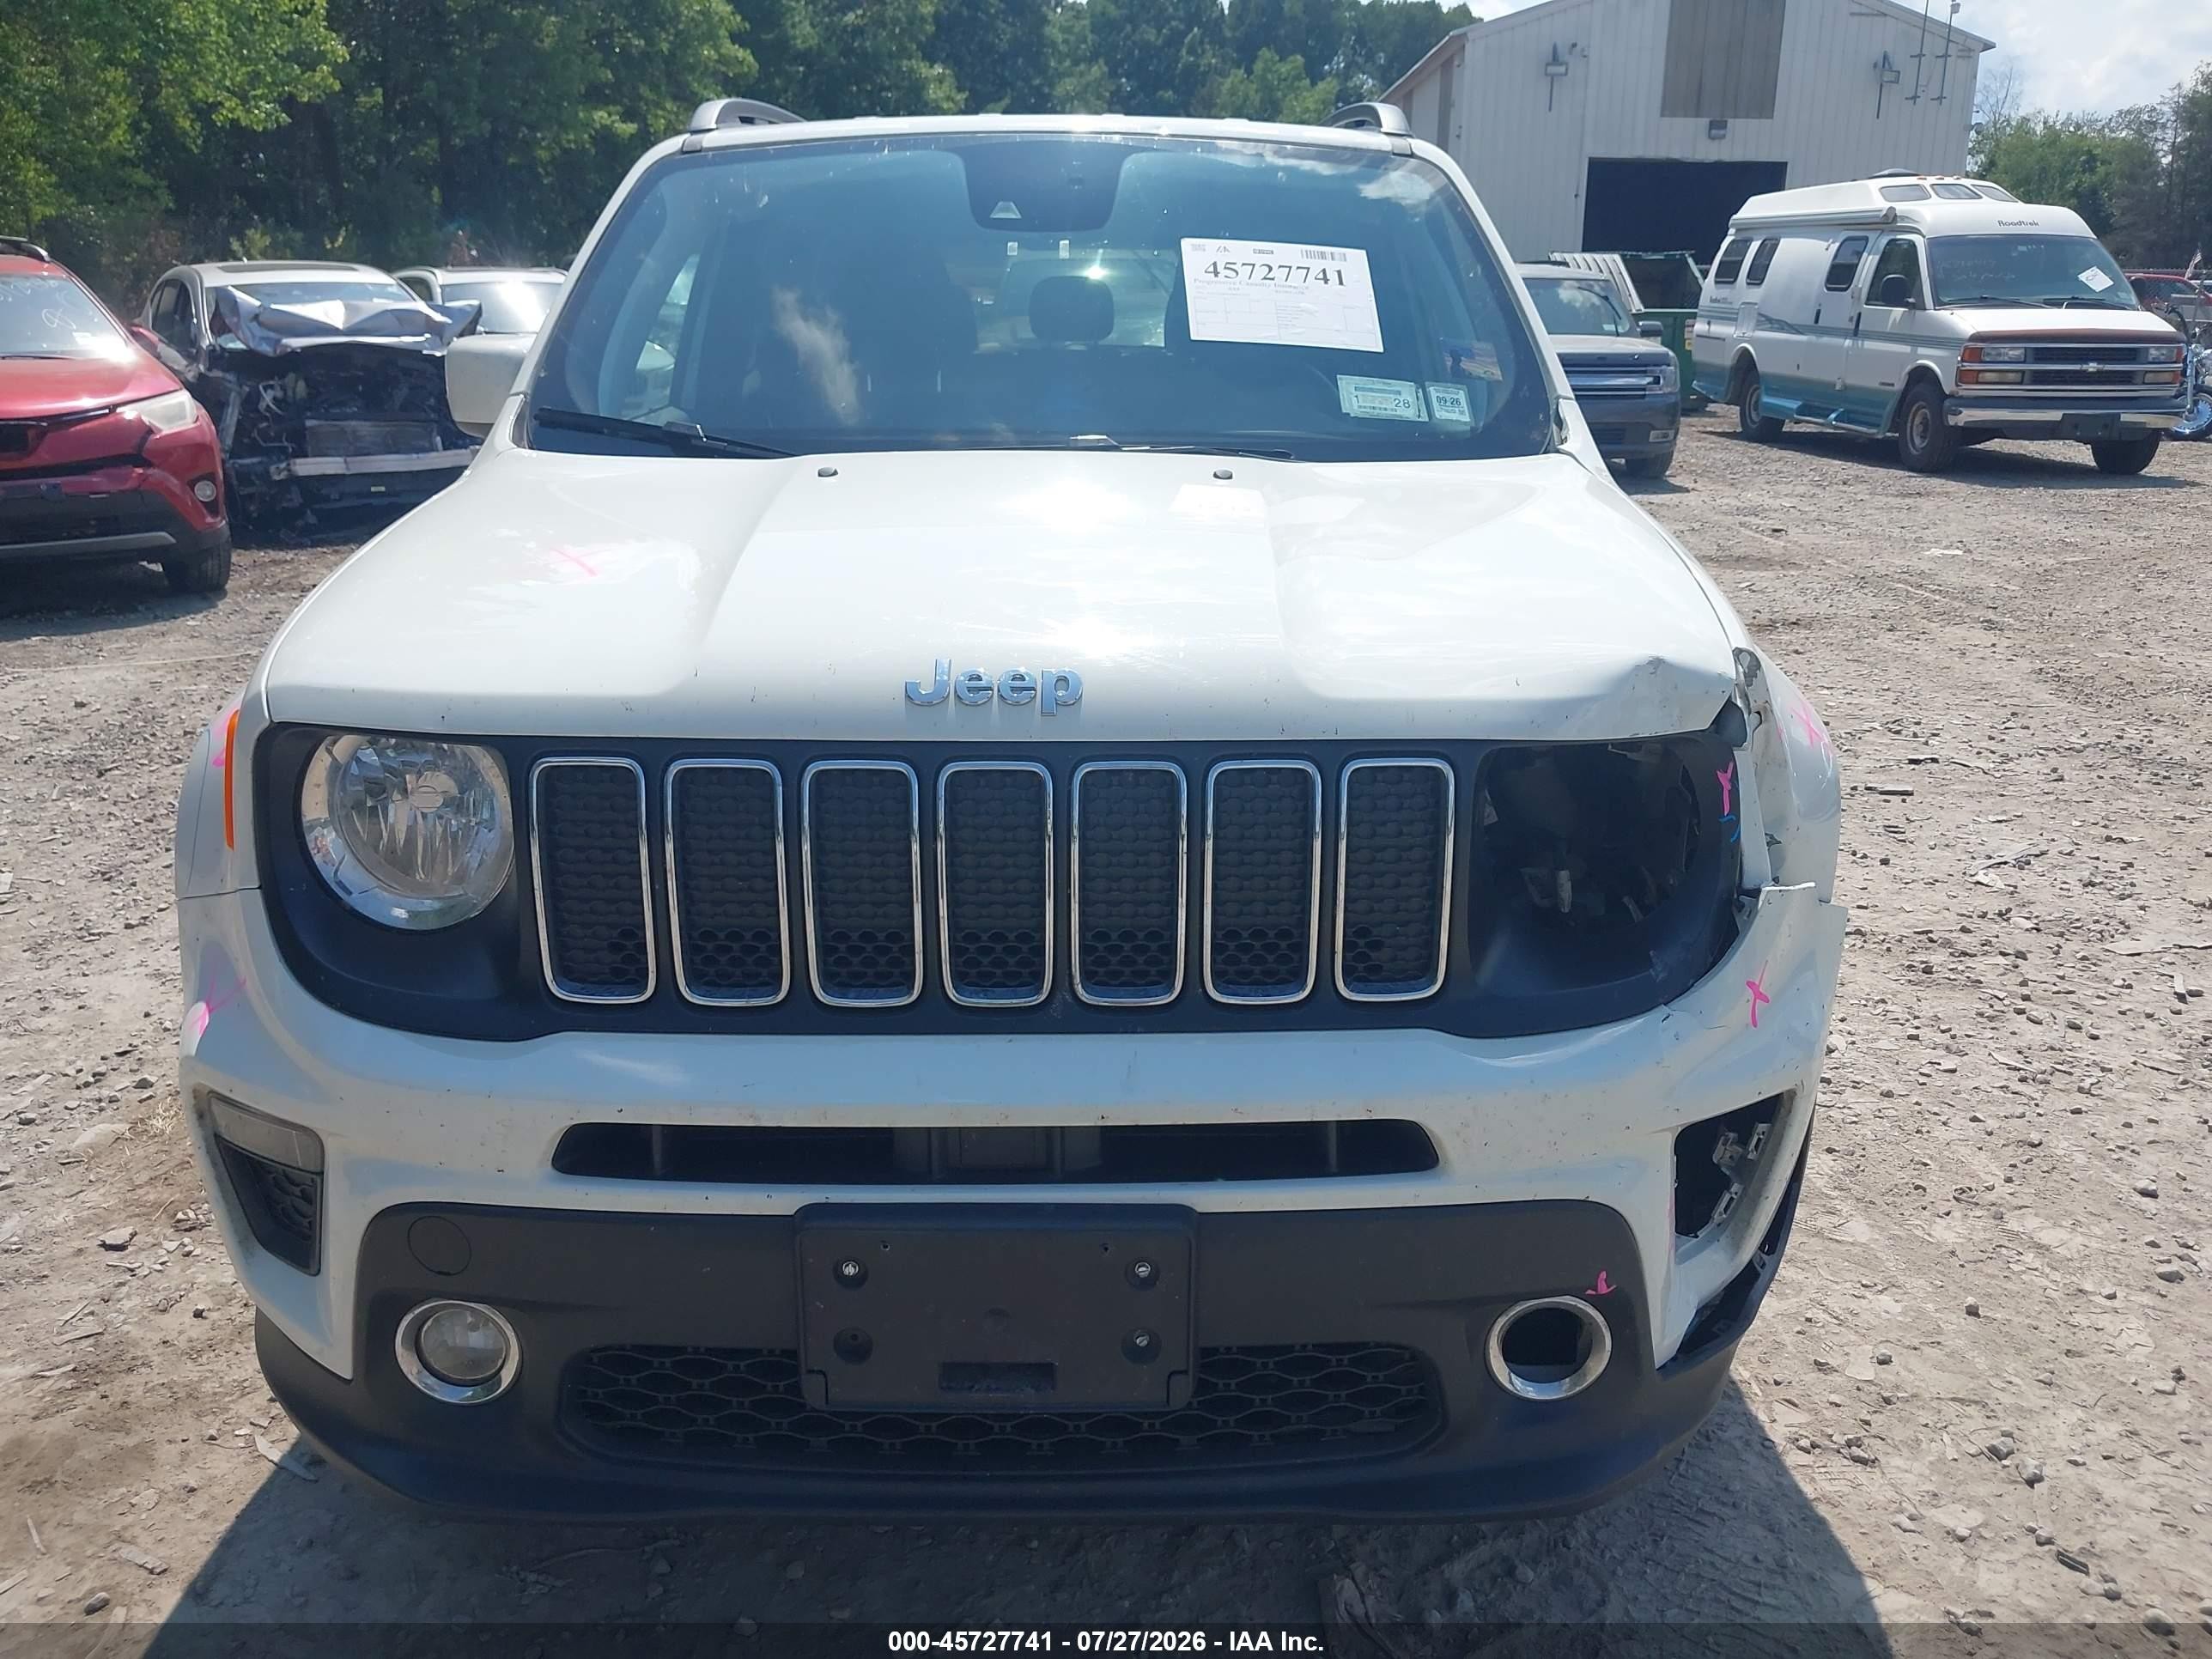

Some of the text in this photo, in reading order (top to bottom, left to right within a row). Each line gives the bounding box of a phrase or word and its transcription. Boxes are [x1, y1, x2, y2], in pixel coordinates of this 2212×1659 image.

[1204, 260, 1346, 287] 45727741
[1394, 398, 1411, 409] 28
[905, 659, 1083, 715] Jeep
